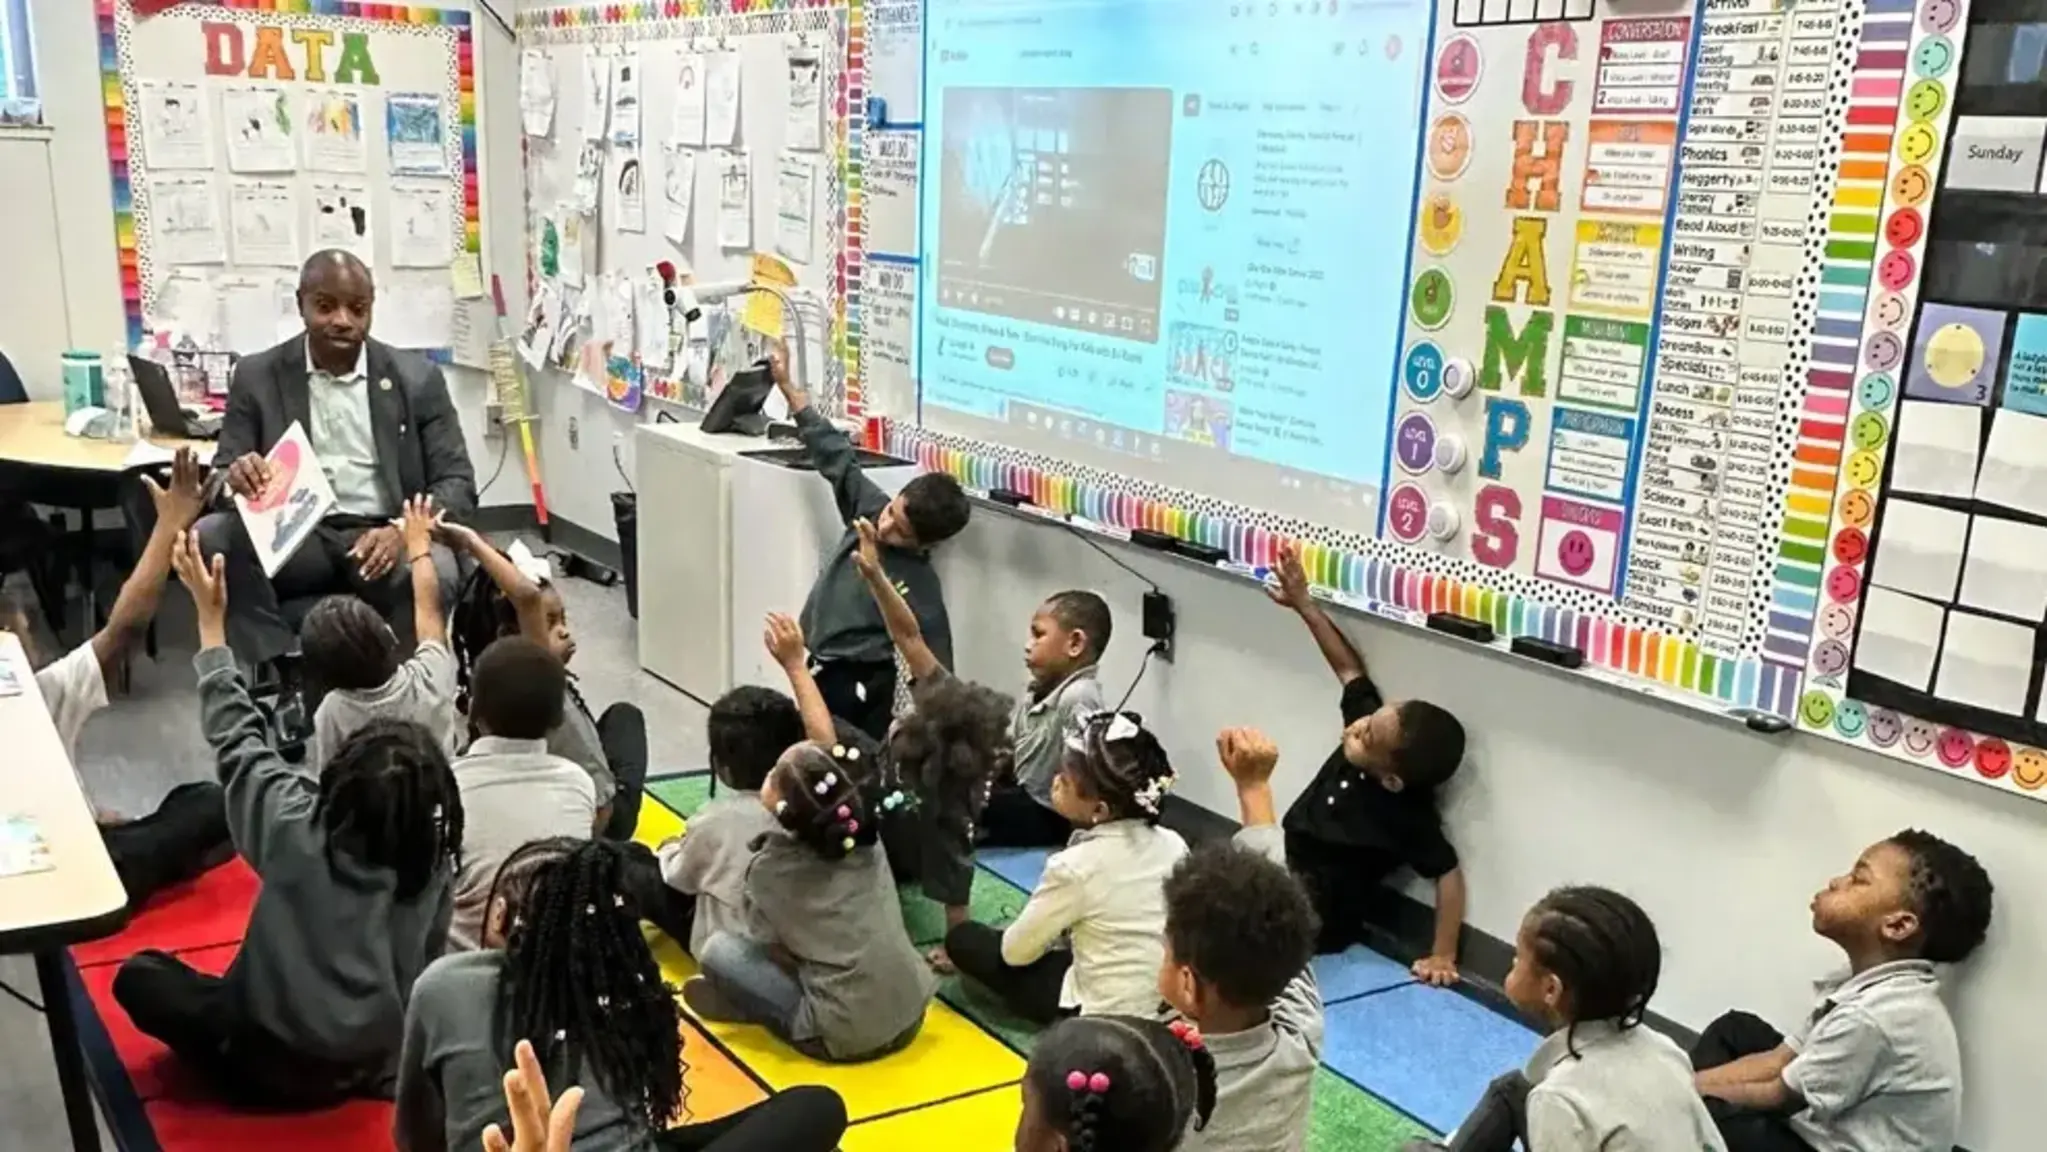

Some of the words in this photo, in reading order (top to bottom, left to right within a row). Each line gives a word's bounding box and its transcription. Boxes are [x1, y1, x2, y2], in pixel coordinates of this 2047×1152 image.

[1702, 21, 1760, 35] Breakfast
[201, 21, 380, 85] DATA
[1598, 90, 1607, 104] 2
[1682, 146, 1729, 162] Phonics
[1967, 143, 2024, 164] Sunday
[1682, 173, 1735, 187] Heggerty
[1676, 218, 1704, 232] Read
[1706, 221, 1738, 233] Aloud
[1673, 243, 1716, 262] Writing
[1662, 313, 1702, 329] Bridges
[1659, 339, 1715, 355] DreamBox
[1660, 355, 1707, 374] Specials
[1416, 370, 1429, 390] 0
[1656, 379, 1690, 395] Lunch
[1975, 384, 1987, 401] 3
[1655, 402, 1694, 419] Recess
[1410, 443, 1418, 461] 1
[1643, 488, 1686, 507] Science
[1401, 512, 1414, 532] 2
[1638, 511, 1668, 528] Exact
[1669, 517, 1695, 533] Path
[1629, 553, 1662, 570] Snack
[1623, 595, 1674, 618] Dismissal
